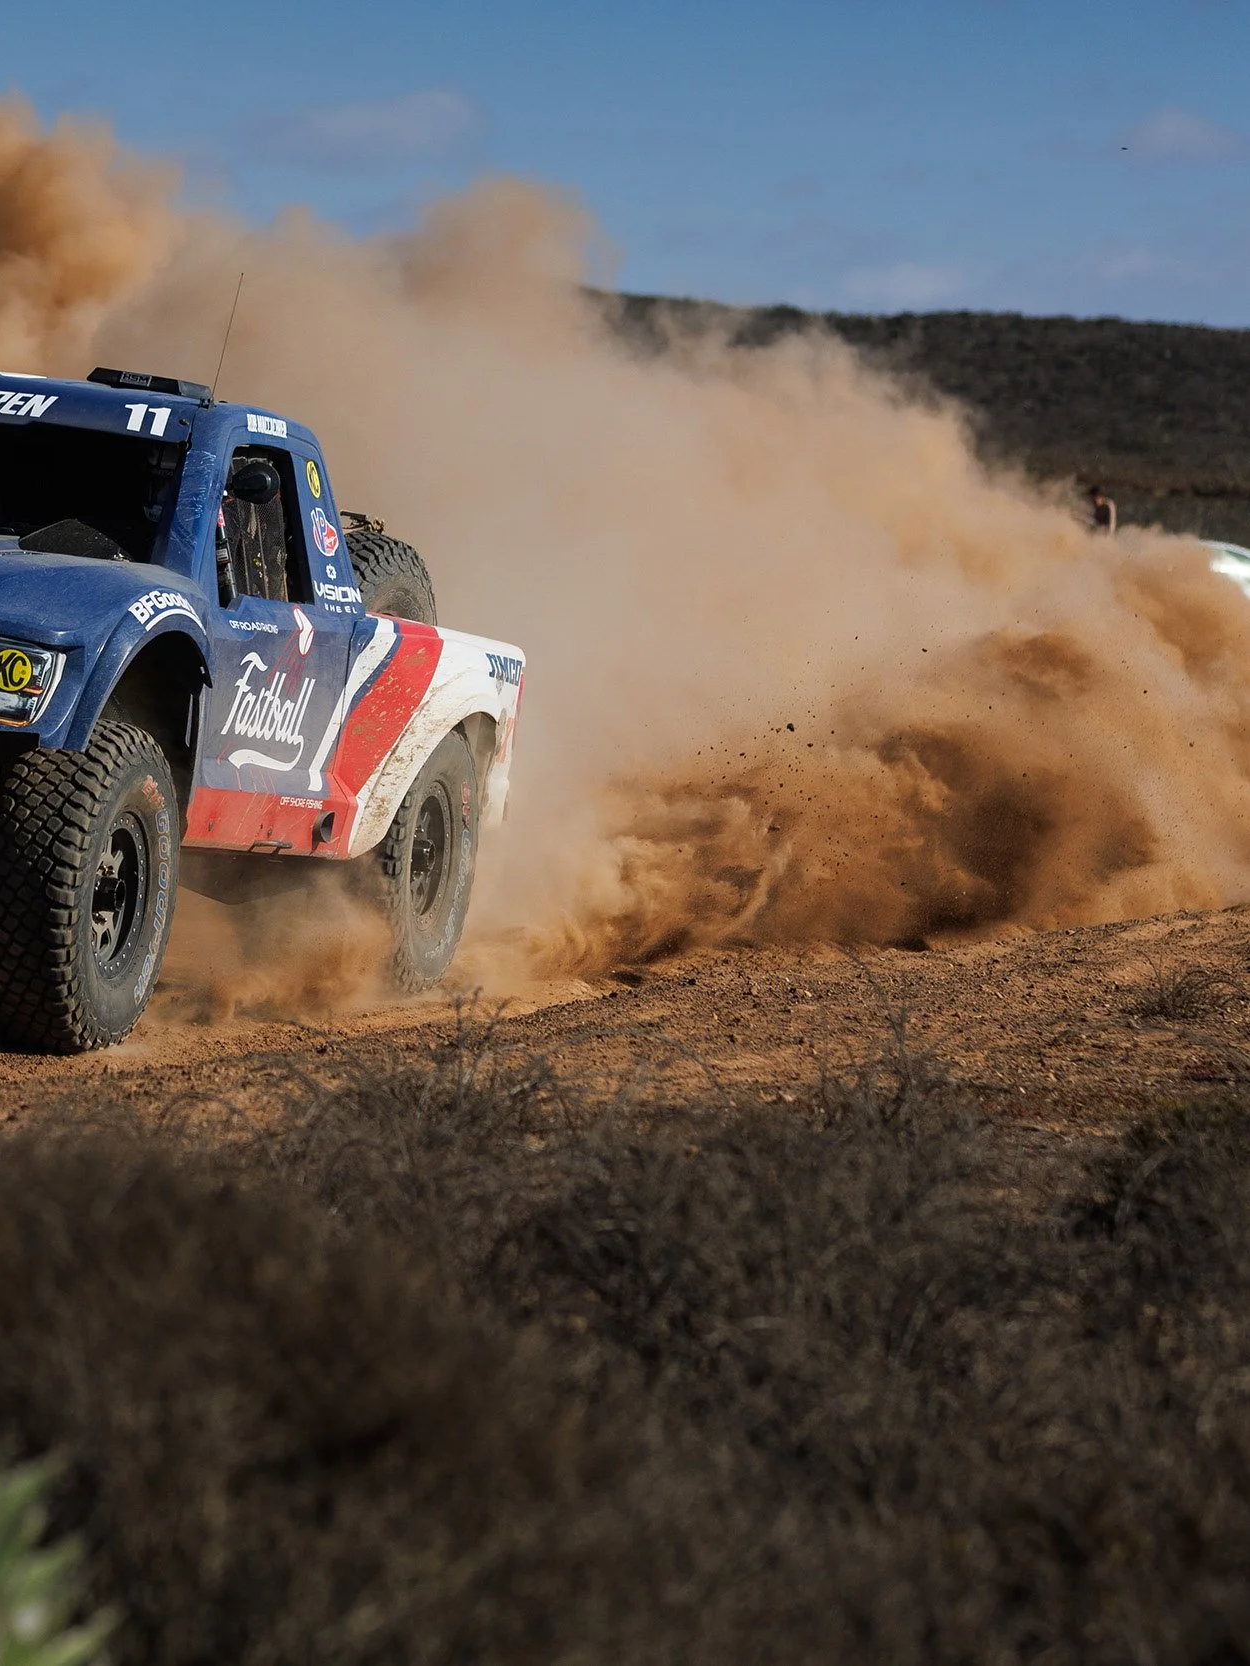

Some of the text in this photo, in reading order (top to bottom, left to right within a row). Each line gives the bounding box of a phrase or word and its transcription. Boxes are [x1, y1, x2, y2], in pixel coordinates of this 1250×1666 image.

[124, 402, 172, 437] 11
[314, 580, 362, 603] VISION
[221, 652, 316, 747] Fastball
